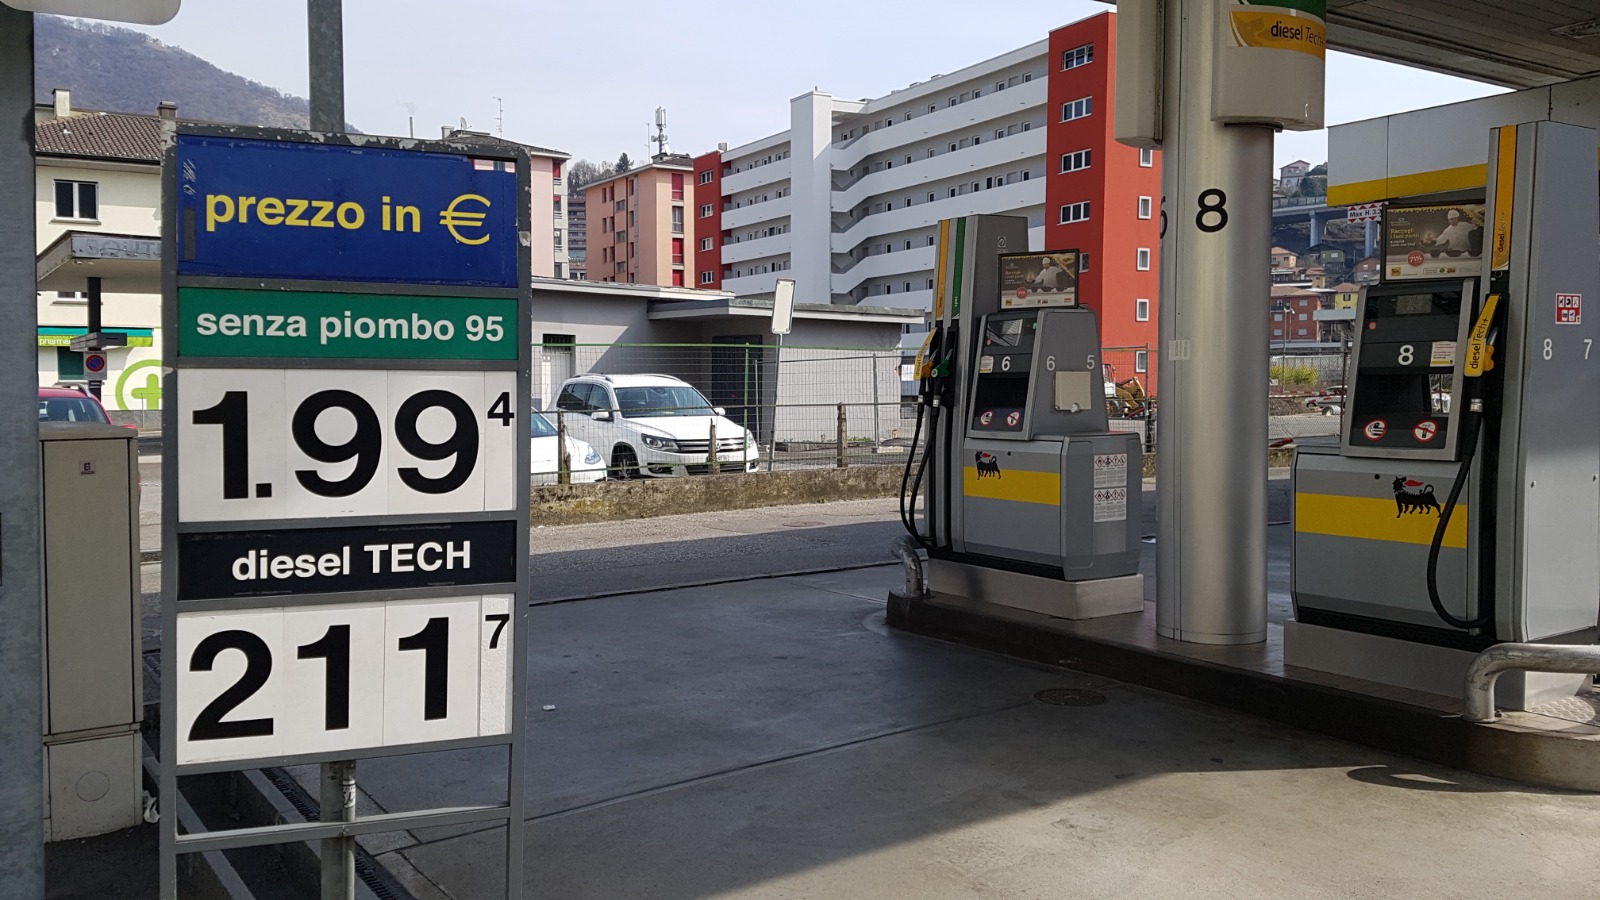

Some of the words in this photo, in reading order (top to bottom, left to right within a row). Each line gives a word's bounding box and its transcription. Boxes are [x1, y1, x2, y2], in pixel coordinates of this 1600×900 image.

[1270, 20, 1303, 41] diesel
[206, 194, 365, 232] prezzo
[381, 195, 421, 233] in
[439, 193, 490, 245] €
[1196, 188, 1229, 233] 8
[1497, 234, 1505, 252] diesel
[197, 311, 307, 337] senza
[320, 310, 455, 345] piombo
[465, 315, 504, 342] 95
[1472, 317, 1489, 342] Tech+
[1397, 344, 1414, 366] 8
[1469, 343, 1481, 369] diesel
[1543, 338, 1553, 360] 8
[1583, 338, 1593, 360] 7
[1001, 356, 1011, 372] 6
[1046, 355, 1056, 371] 6
[1086, 354, 1095, 370] 5
[192, 389, 480, 500] 1.99
[487, 391, 515, 427] 4
[232, 545, 350, 581] diesel
[363, 540, 471, 574] TECH
[187, 616, 450, 742] 211
[485, 613, 510, 649] 7
